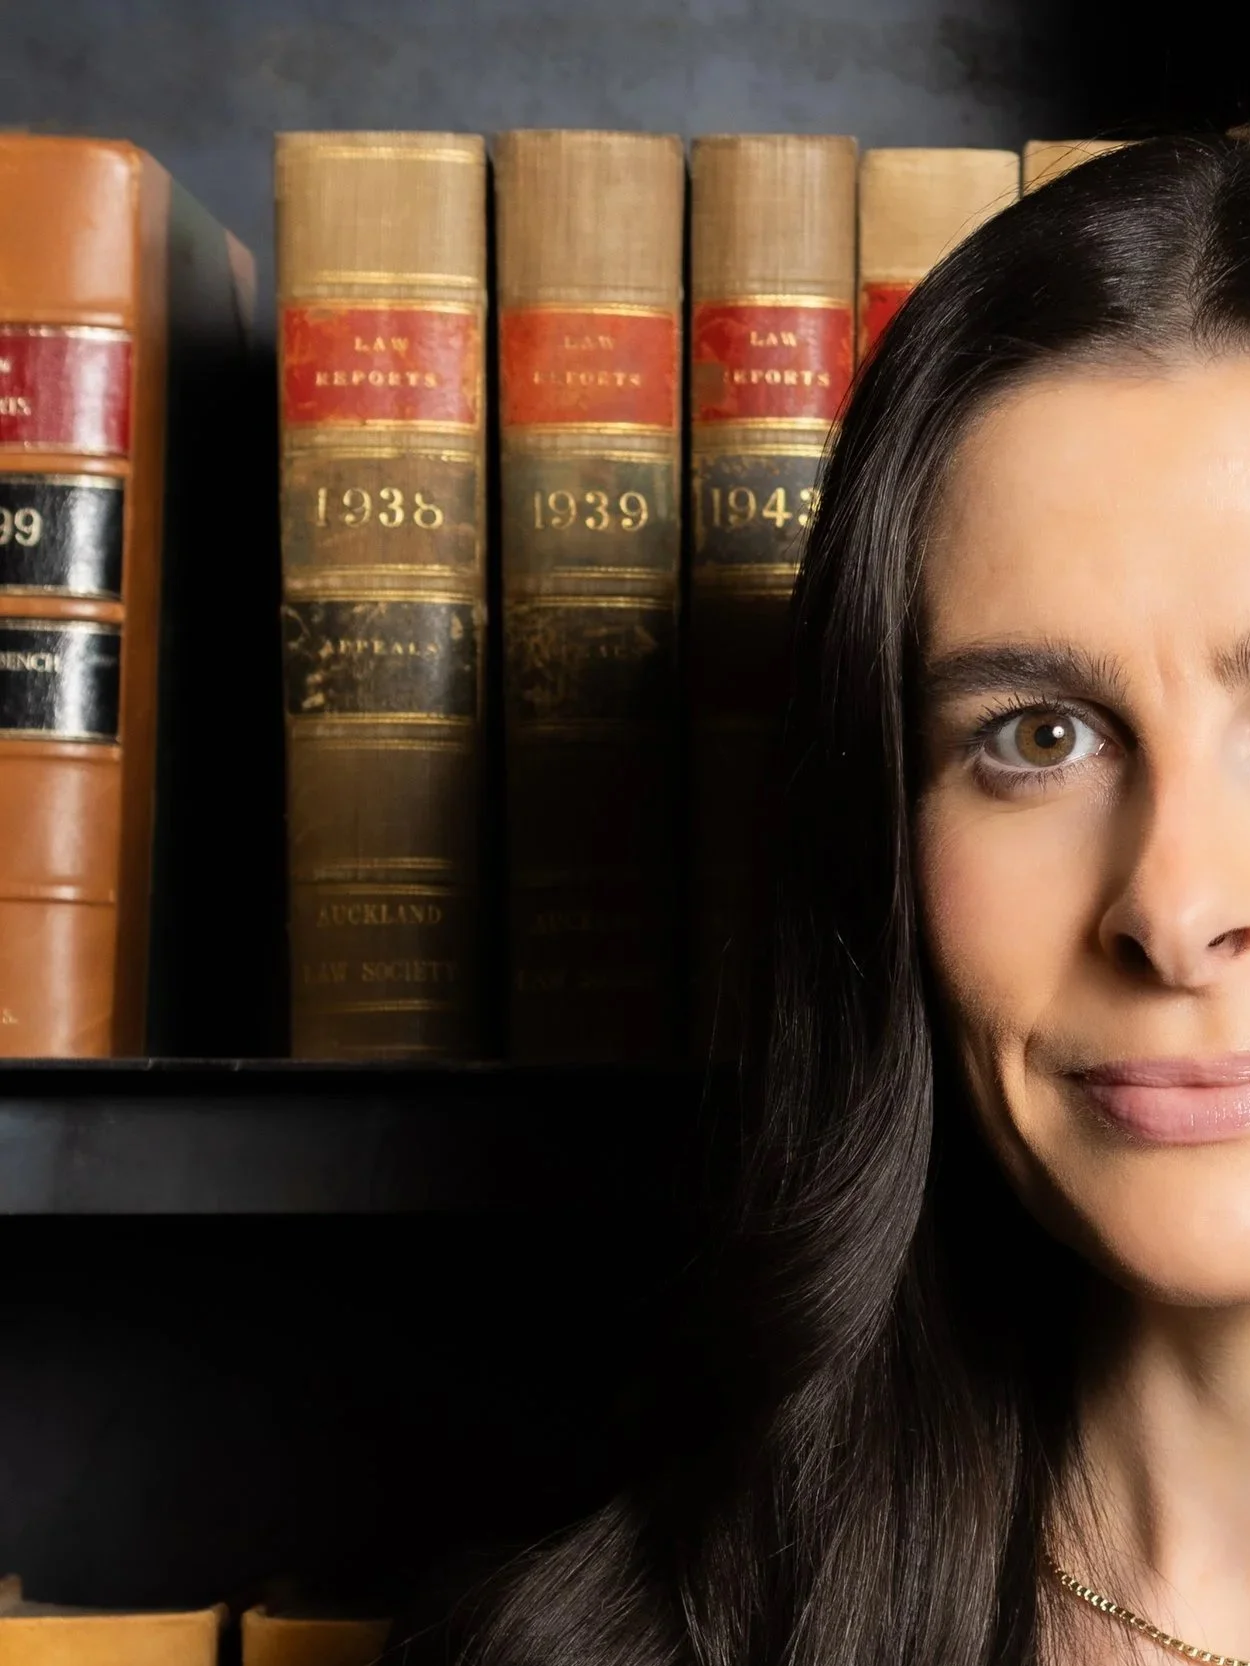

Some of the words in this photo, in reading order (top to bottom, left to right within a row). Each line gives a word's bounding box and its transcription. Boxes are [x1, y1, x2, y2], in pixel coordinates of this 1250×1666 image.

[354, 336, 410, 352] LAW
[563, 335, 617, 352] LAW
[751, 332, 798, 347] LAW
[315, 370, 440, 389] REPORTS
[316, 486, 444, 529] 1938
[533, 489, 650, 532] 1939
[318, 640, 441, 659] APPEALS
[316, 903, 444, 928] AUCKLAND
[302, 961, 348, 985] LAW
[361, 959, 458, 983] SOCIETY
